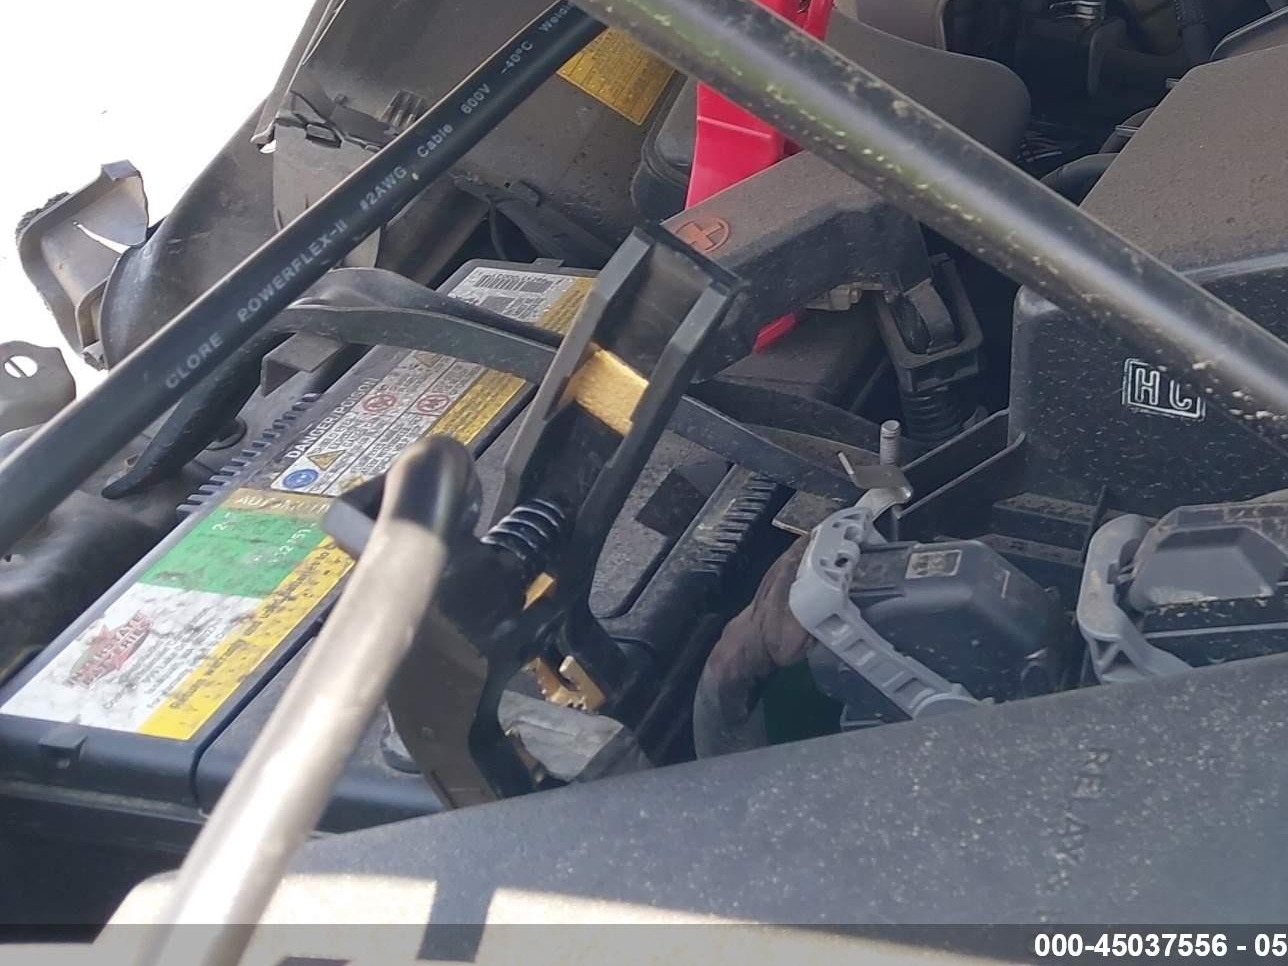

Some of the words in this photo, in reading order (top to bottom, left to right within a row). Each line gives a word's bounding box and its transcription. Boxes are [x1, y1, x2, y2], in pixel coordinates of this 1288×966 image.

[165, 331, 225, 390] CLORE
[416, 123, 455, 159] Cable
[460, 83, 492, 116] 600V
